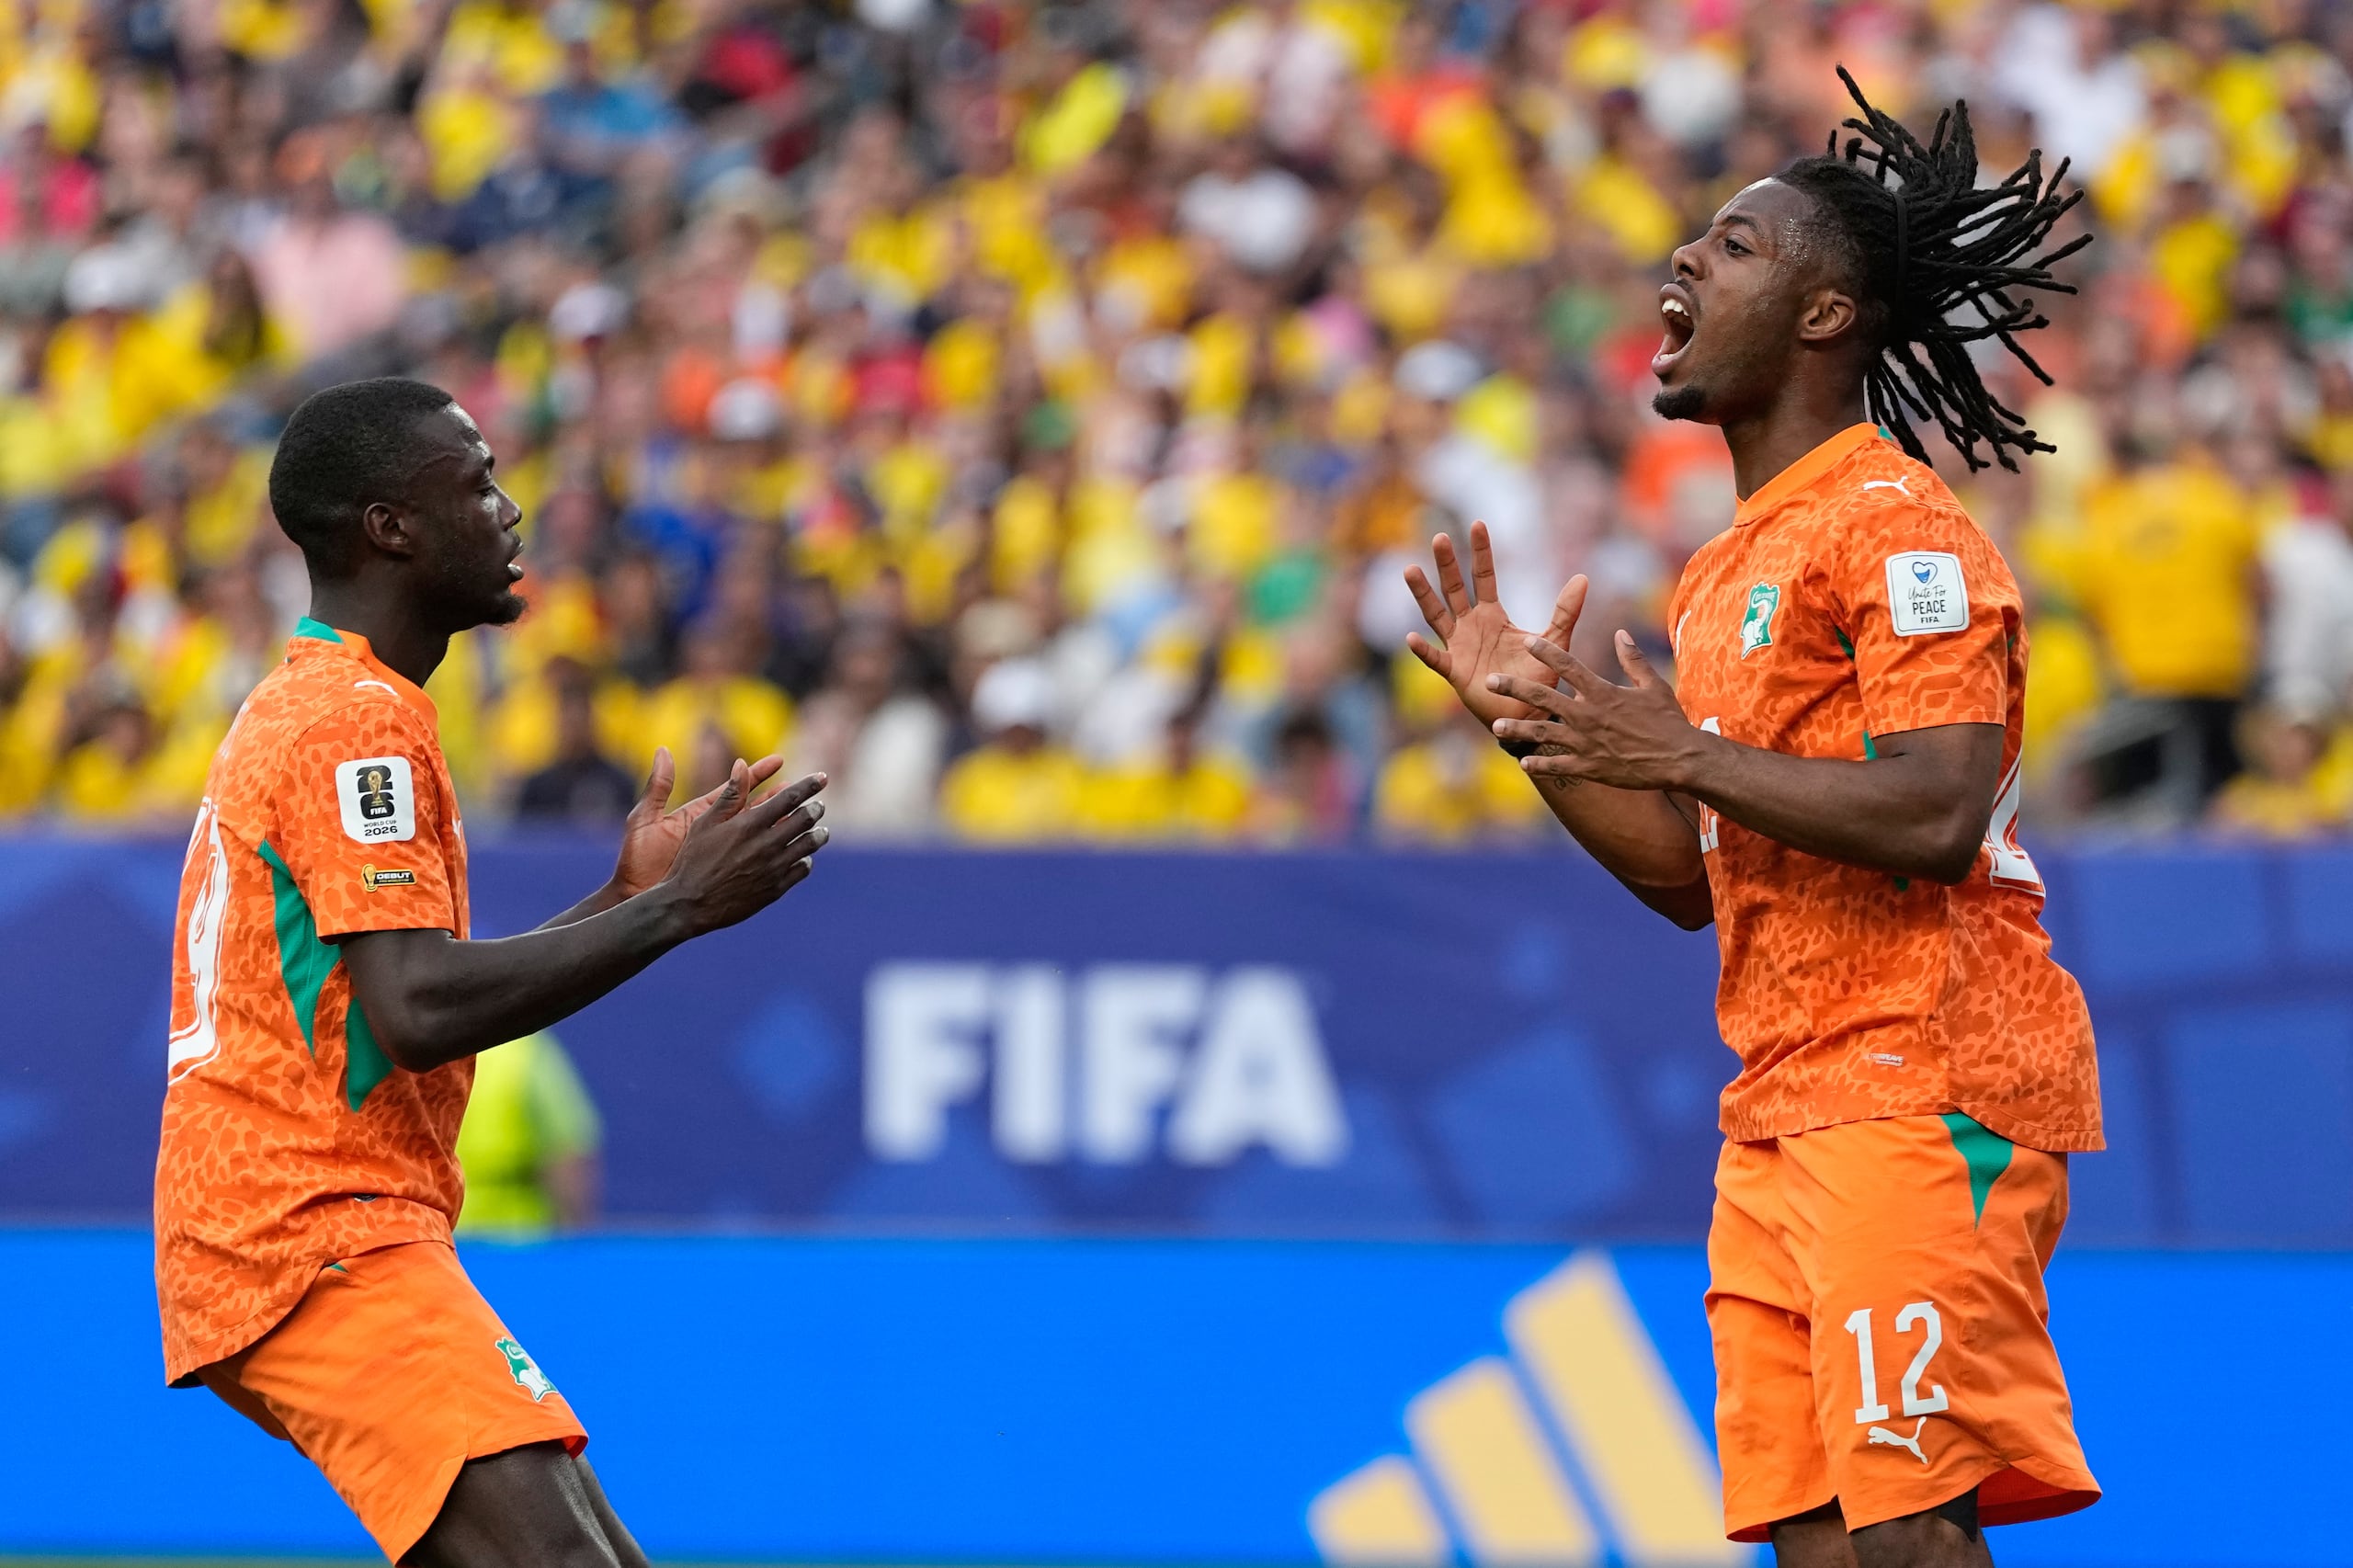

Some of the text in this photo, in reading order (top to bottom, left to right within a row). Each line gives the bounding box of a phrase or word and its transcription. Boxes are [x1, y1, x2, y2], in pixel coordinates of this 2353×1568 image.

[1907, 585, 1947, 601] Unite For
[1912, 599, 1947, 615] PEACE
[1920, 616, 1940, 624] FIFA
[369, 807, 388, 815] FIFA
[364, 825, 398, 836] 2026
[862, 961, 1350, 1168] FIFA
[1844, 1301, 1949, 1425] 12
